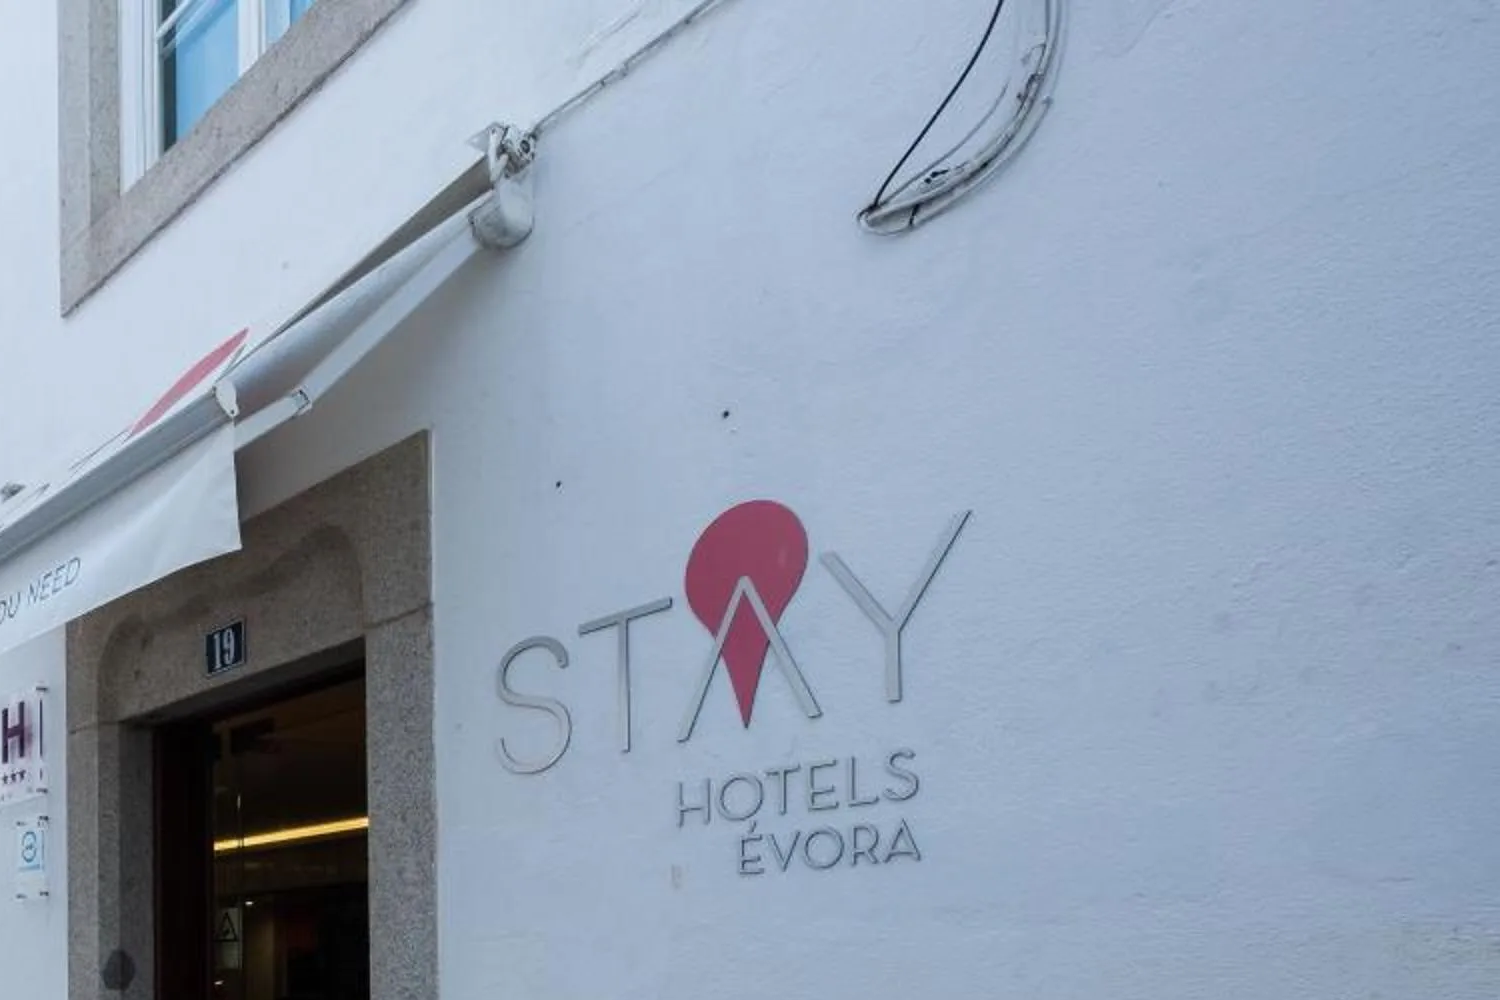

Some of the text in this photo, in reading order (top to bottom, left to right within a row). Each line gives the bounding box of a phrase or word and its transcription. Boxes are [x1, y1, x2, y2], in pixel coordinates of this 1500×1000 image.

[27, 556, 82, 606] NEED
[214, 627, 235, 669] 19
[496, 510, 973, 775] STAY
[2, 701, 25, 764] H
[676, 748, 921, 828] HOTELS
[738, 818, 922, 876] ÉVORA
